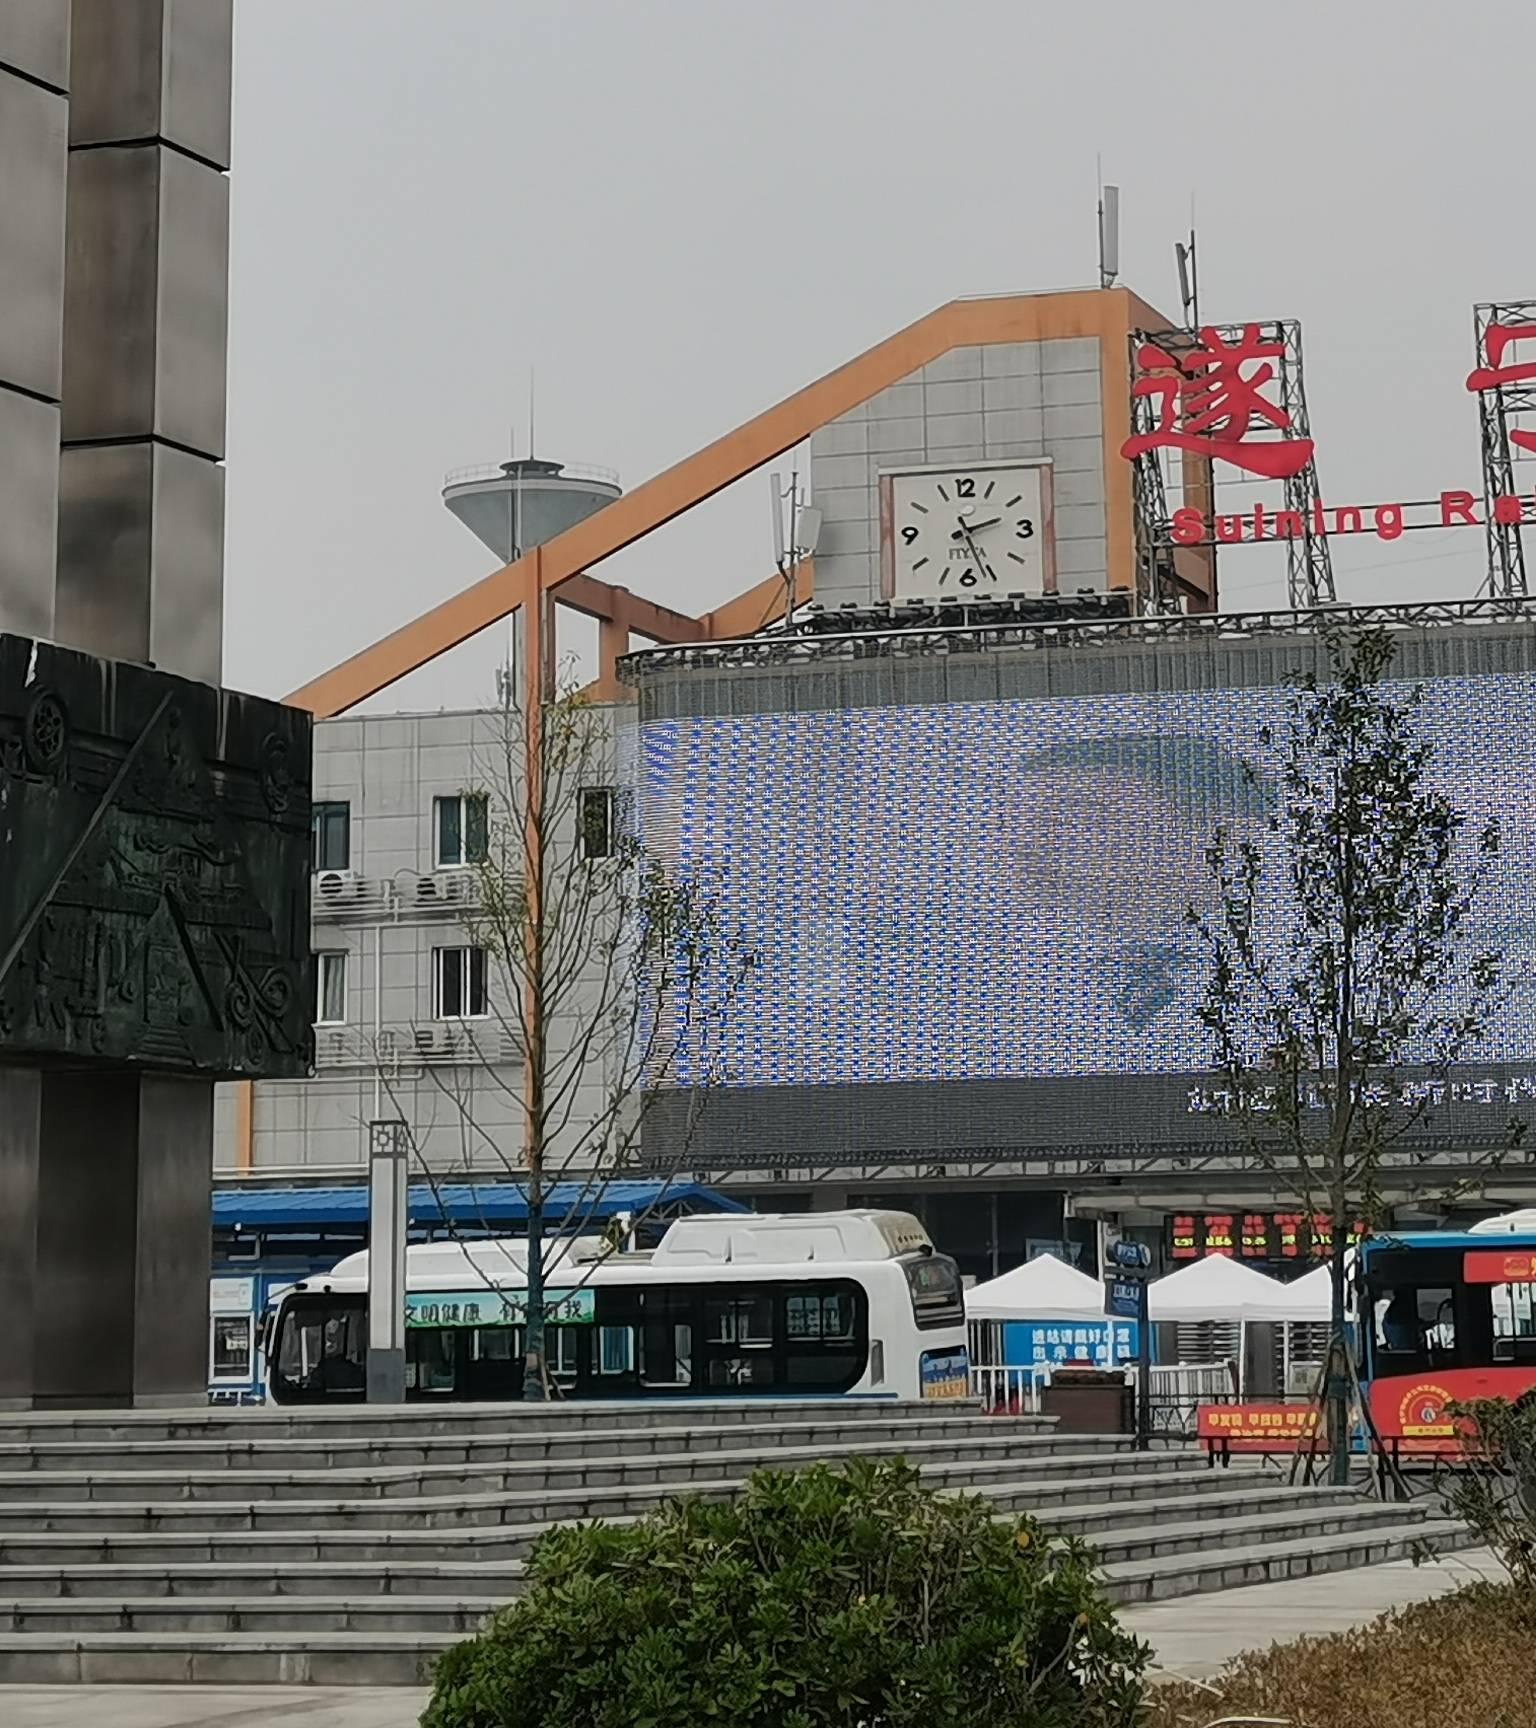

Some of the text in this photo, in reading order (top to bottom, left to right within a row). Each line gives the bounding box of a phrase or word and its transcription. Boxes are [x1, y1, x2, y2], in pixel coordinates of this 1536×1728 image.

[955, 478, 976, 498] 12
[1170, 497, 1404, 544] Suining
[901, 519, 1034, 546] 9 3
[959, 568, 977, 587] 6
